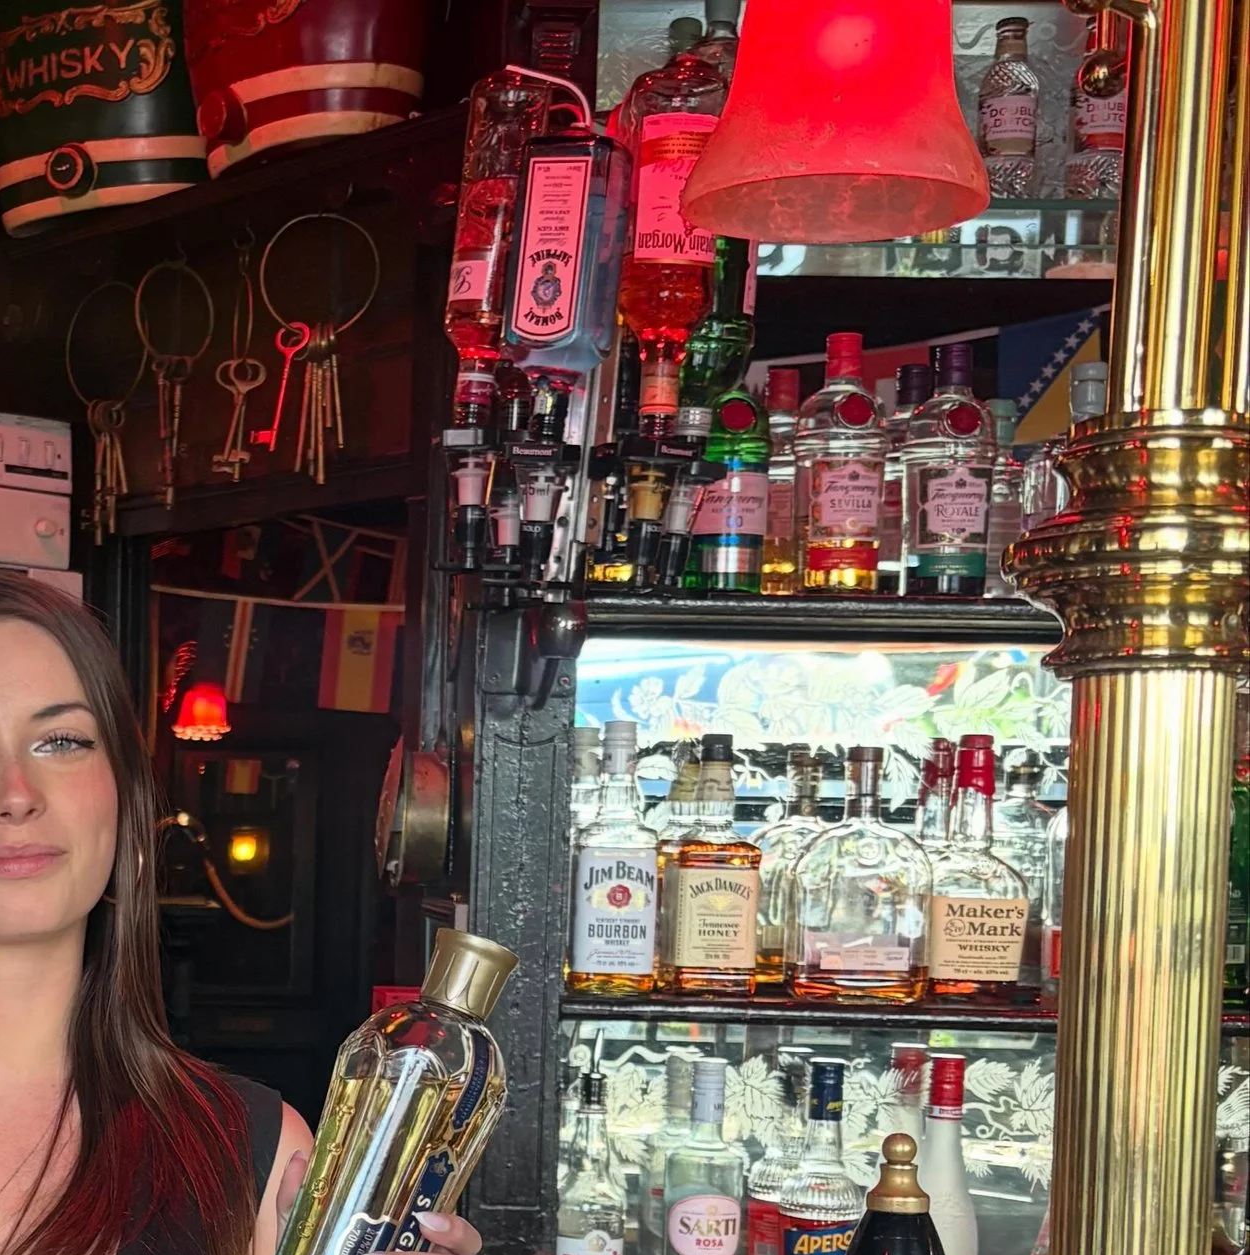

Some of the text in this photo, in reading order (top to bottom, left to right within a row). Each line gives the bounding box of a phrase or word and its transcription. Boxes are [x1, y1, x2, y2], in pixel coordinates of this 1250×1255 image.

[6, 38, 135, 89] WHISKY
[638, 230, 685, 255] Morgan
[530, 248, 573, 268] SAPPHIRE
[523, 305, 565, 327] BOMBAY
[512, 446, 553, 456] Beaumont
[824, 481, 877, 495] Tanqueray
[830, 499, 872, 509] SEVILLA
[934, 504, 980, 516] ROYALE
[583, 860, 655, 892] JIM BEAM
[689, 878, 752, 901] JACK DANIEL'S
[946, 903, 1025, 919] Maker's
[588, 924, 647, 939] BOURBON
[698, 929, 740, 938] HONEY
[967, 921, 1022, 937] Mark
[958, 944, 1010, 953] WHISKY
[678, 1215, 736, 1237] SARTI
[695, 1238, 724, 1248] ROSA
[793, 1230, 854, 1255] APERO
